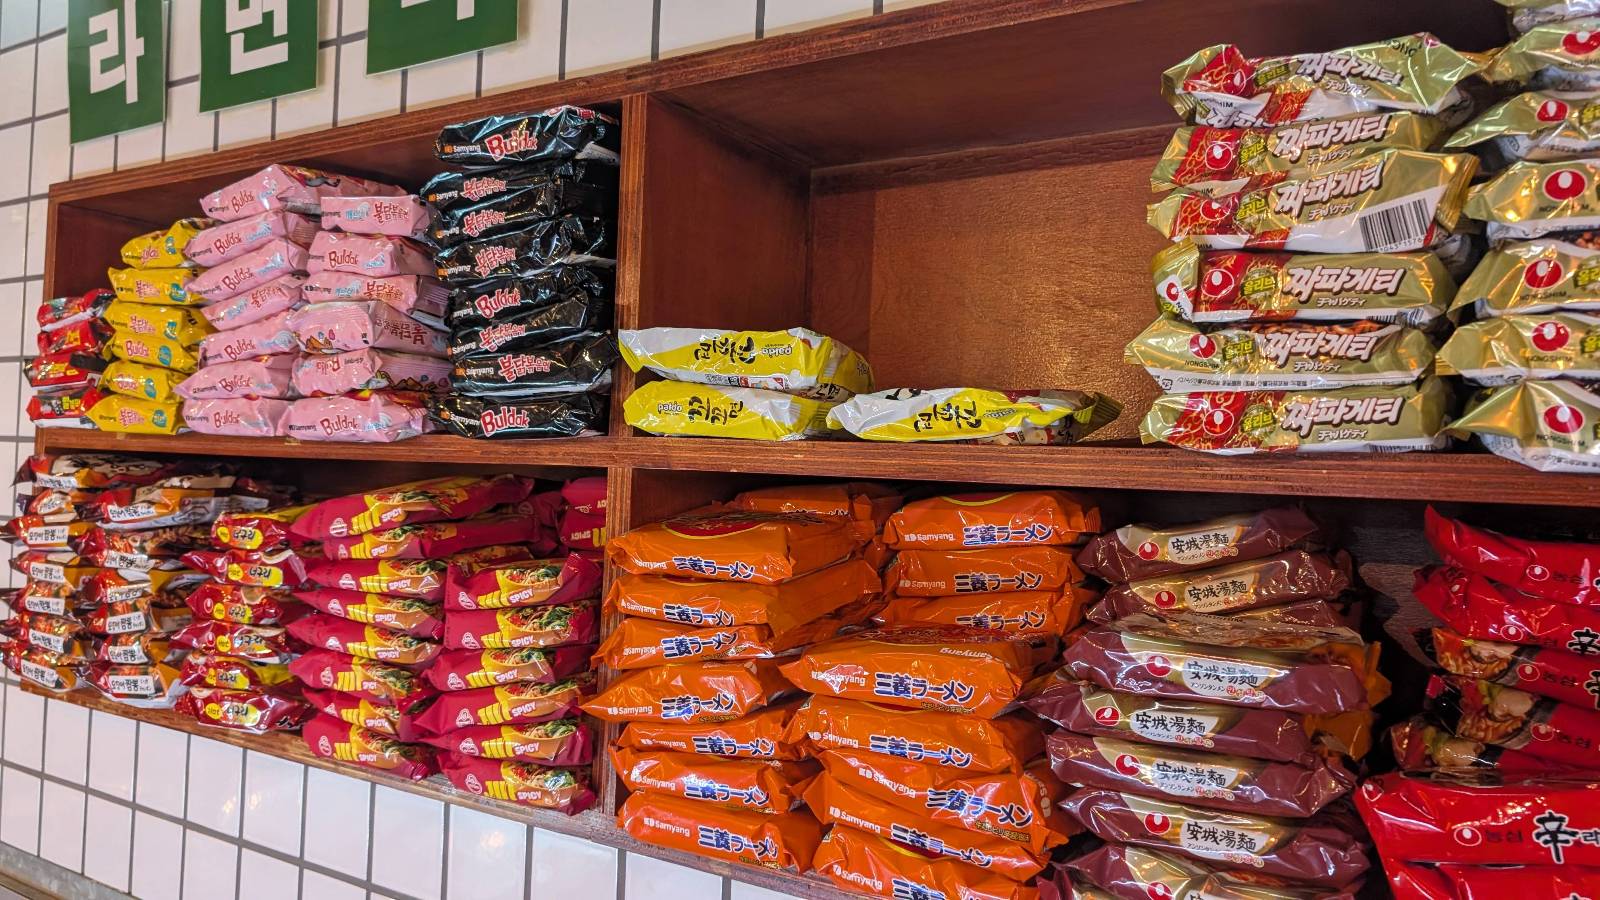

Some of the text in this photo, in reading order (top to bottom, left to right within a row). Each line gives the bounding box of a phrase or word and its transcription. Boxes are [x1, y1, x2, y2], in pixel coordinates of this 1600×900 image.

[89, 0, 144, 104] 라
[1296, 51, 1404, 87] 짜파게티
[453, 130, 538, 161] Samyang Buldak
[1273, 114, 1392, 164] 짜파게티
[1275, 160, 1384, 217] 짜파게티
[214, 234, 243, 256] Buldak
[328, 250, 359, 268] Buldak
[222, 267, 254, 291] Buldak
[1243, 266, 1406, 303] 올리브 짜파게티
[452, 287, 522, 319] amyang Buldak
[223, 339, 257, 361] Buldak
[761, 345, 793, 358] paldo
[1225, 330, 1378, 367] 올리브 짜파게티
[498, 354, 551, 383] 불닭볶음면
[219, 375, 253, 393] Buldak
[657, 401, 683, 414] paldo
[1243, 396, 1405, 438] 올리브 짜파게티
[213, 412, 241, 428] Buldak
[320, 414, 359, 436] Buldak
[480, 406, 531, 437] Buldak
[380, 507, 403, 522] SPICY
[917, 532, 955, 542] Samyang
[370, 544, 389, 557] SPICY
[388, 579, 411, 591] SPICY
[911, 572, 1044, 593] Samyang 三養ラーメン
[508, 587, 534, 604] SPICY
[374, 612, 397, 623] SPICY
[511, 635, 534, 648] SPICY
[660, 631, 738, 659] 三養ラーメン
[376, 650, 400, 659] SPICY
[495, 668, 518, 683] SPICY
[874, 671, 975, 703] 三養ラーメン
[510, 701, 537, 717] SPICY
[618, 705, 653, 716] Samyang
[512, 742, 540, 755] SPICY
[641, 775, 676, 791] Samyang
[516, 790, 542, 801] SPICY
[654, 819, 691, 838] Samyang
[841, 811, 881, 834] Samyang
